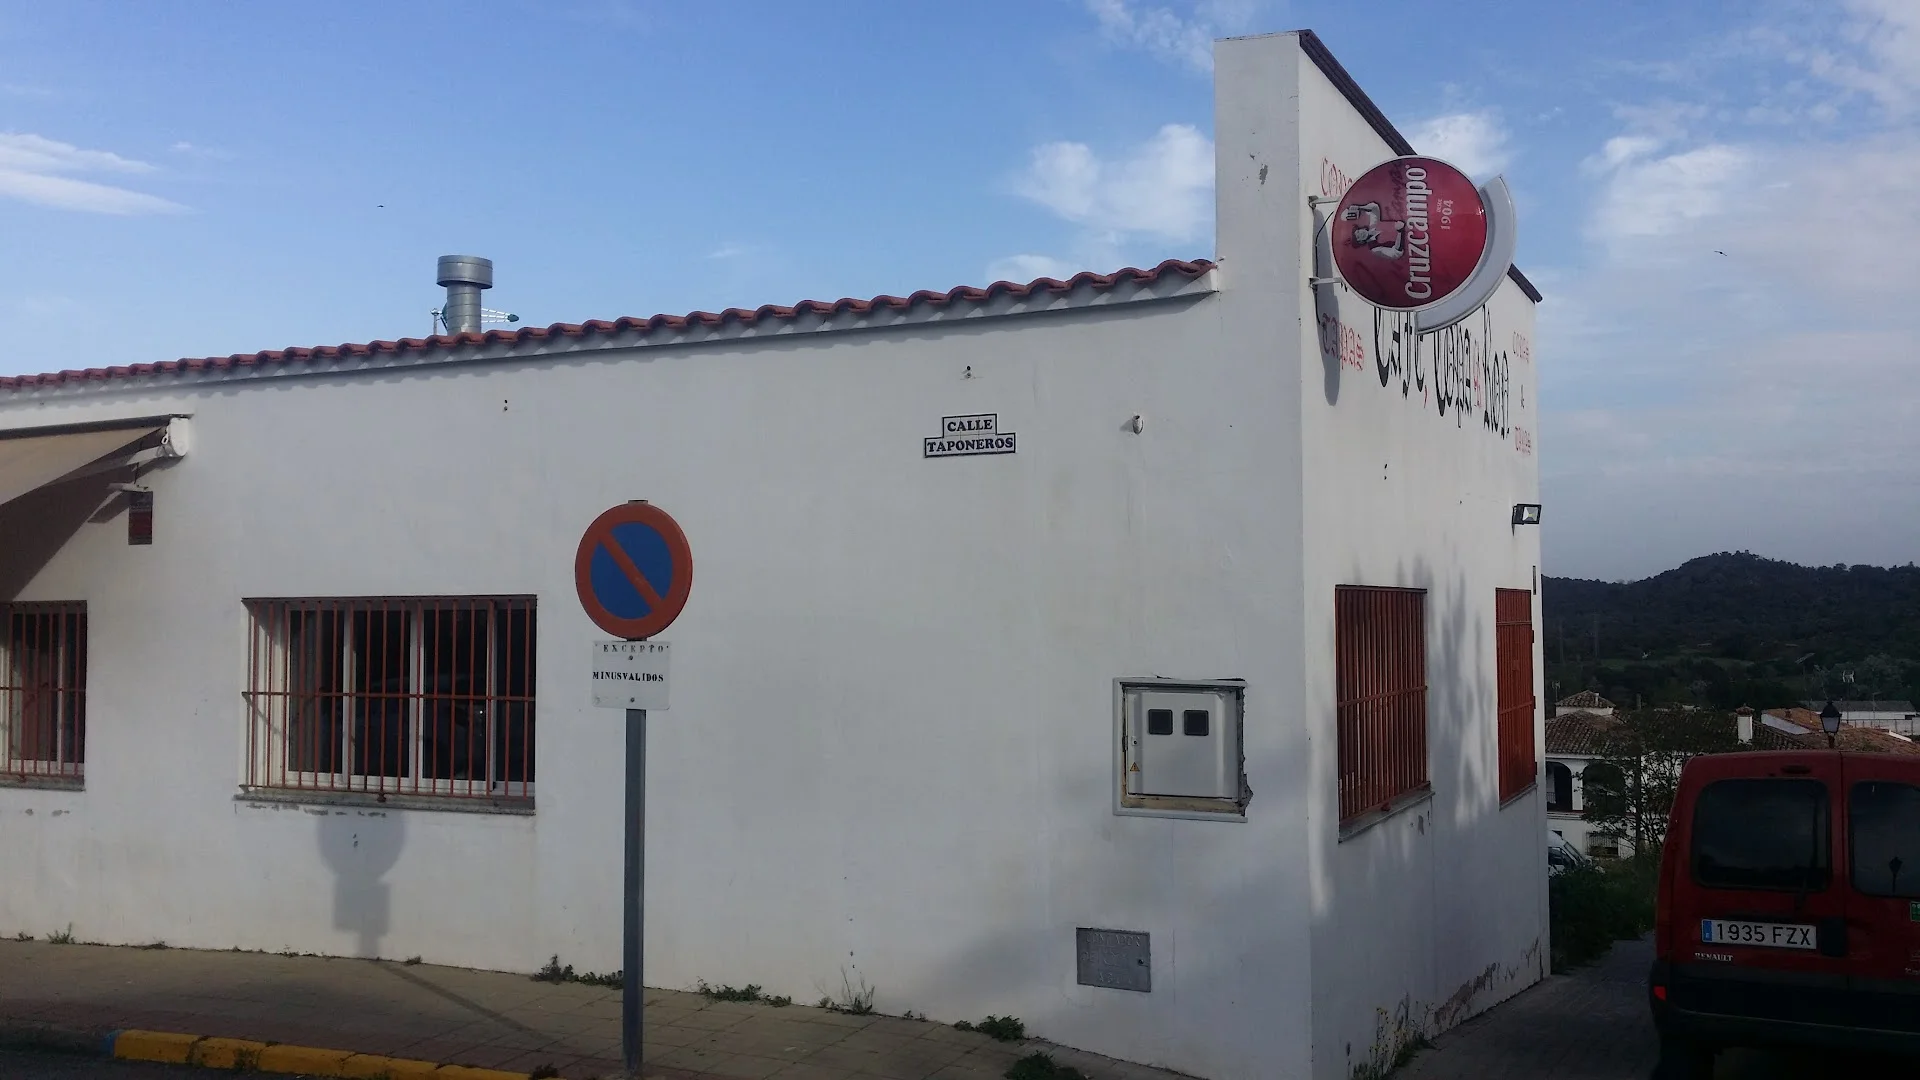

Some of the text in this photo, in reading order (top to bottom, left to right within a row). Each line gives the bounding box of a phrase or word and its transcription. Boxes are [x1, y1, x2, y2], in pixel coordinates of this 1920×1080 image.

[1440, 199, 1454, 230] 1904
[1405, 166, 1432, 299] Cruzcampo
[947, 419, 992, 432] CALLE
[927, 437, 1013, 452] TAPONEROS
[592, 671, 664, 682] MINUSVALIDOS
[1716, 923, 1811, 946] 1935 FZX
[1694, 952, 1734, 962] RENAULT
